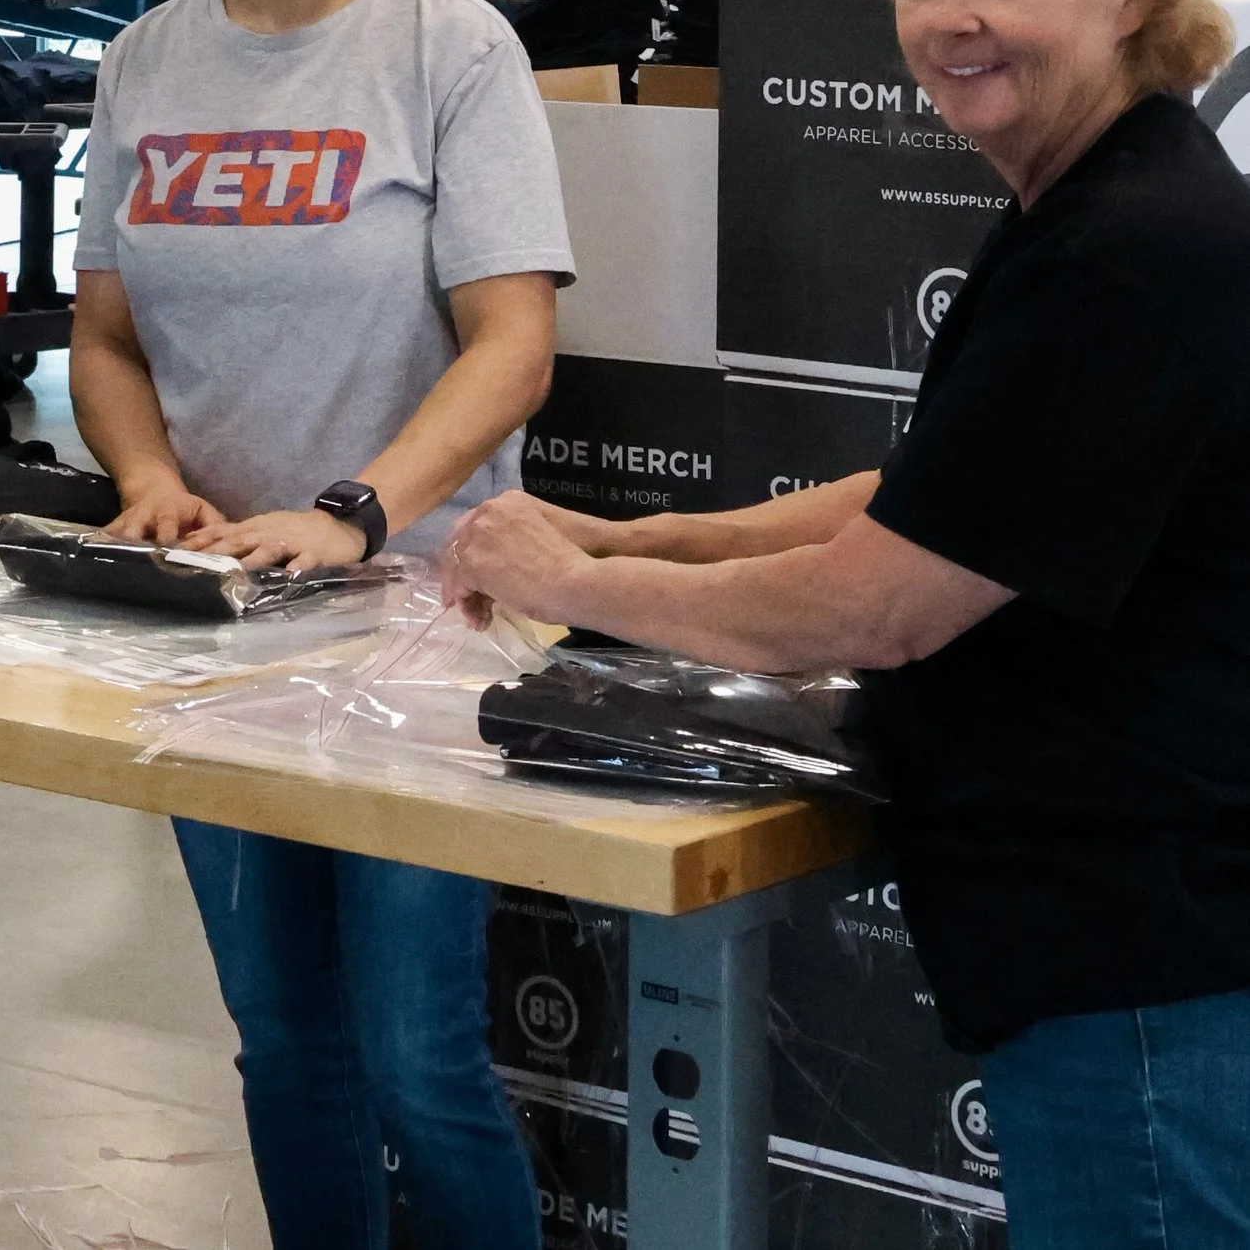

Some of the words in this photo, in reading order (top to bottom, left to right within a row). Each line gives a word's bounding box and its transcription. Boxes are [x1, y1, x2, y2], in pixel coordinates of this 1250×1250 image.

[762, 77, 901, 112] CUSTOM
[803, 125, 882, 145] APPAREL
[146, 148, 341, 207] YETI
[602, 443, 713, 481] MERCH
[624, 489, 672, 508] MORE
[835, 918, 915, 948] APPAREL
[528, 995, 566, 1031] 85
